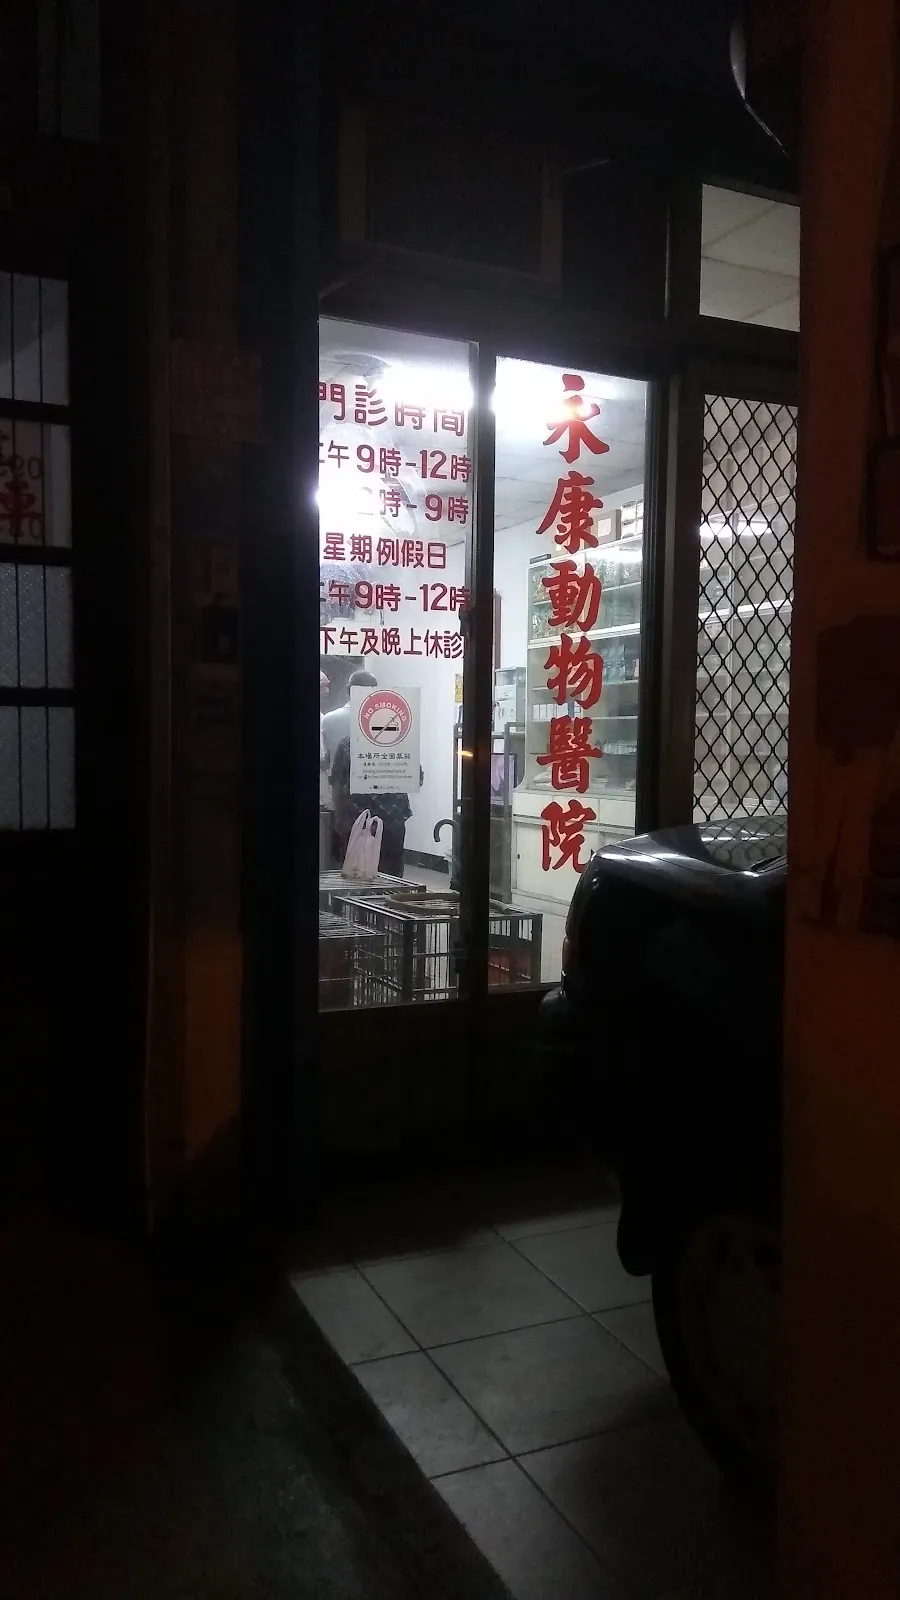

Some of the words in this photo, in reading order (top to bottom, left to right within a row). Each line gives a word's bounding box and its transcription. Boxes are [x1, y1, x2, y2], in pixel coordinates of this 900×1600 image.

[318, 382, 465, 437] 門診時間
[323, 532, 447, 569] 星期例假日
[535, 373, 610, 874] 永康動物醫院
[320, 626, 463, 659] 下午及晚上休診
[363, 707, 374, 720] NO
[374, 701, 408, 722] SMOKING
